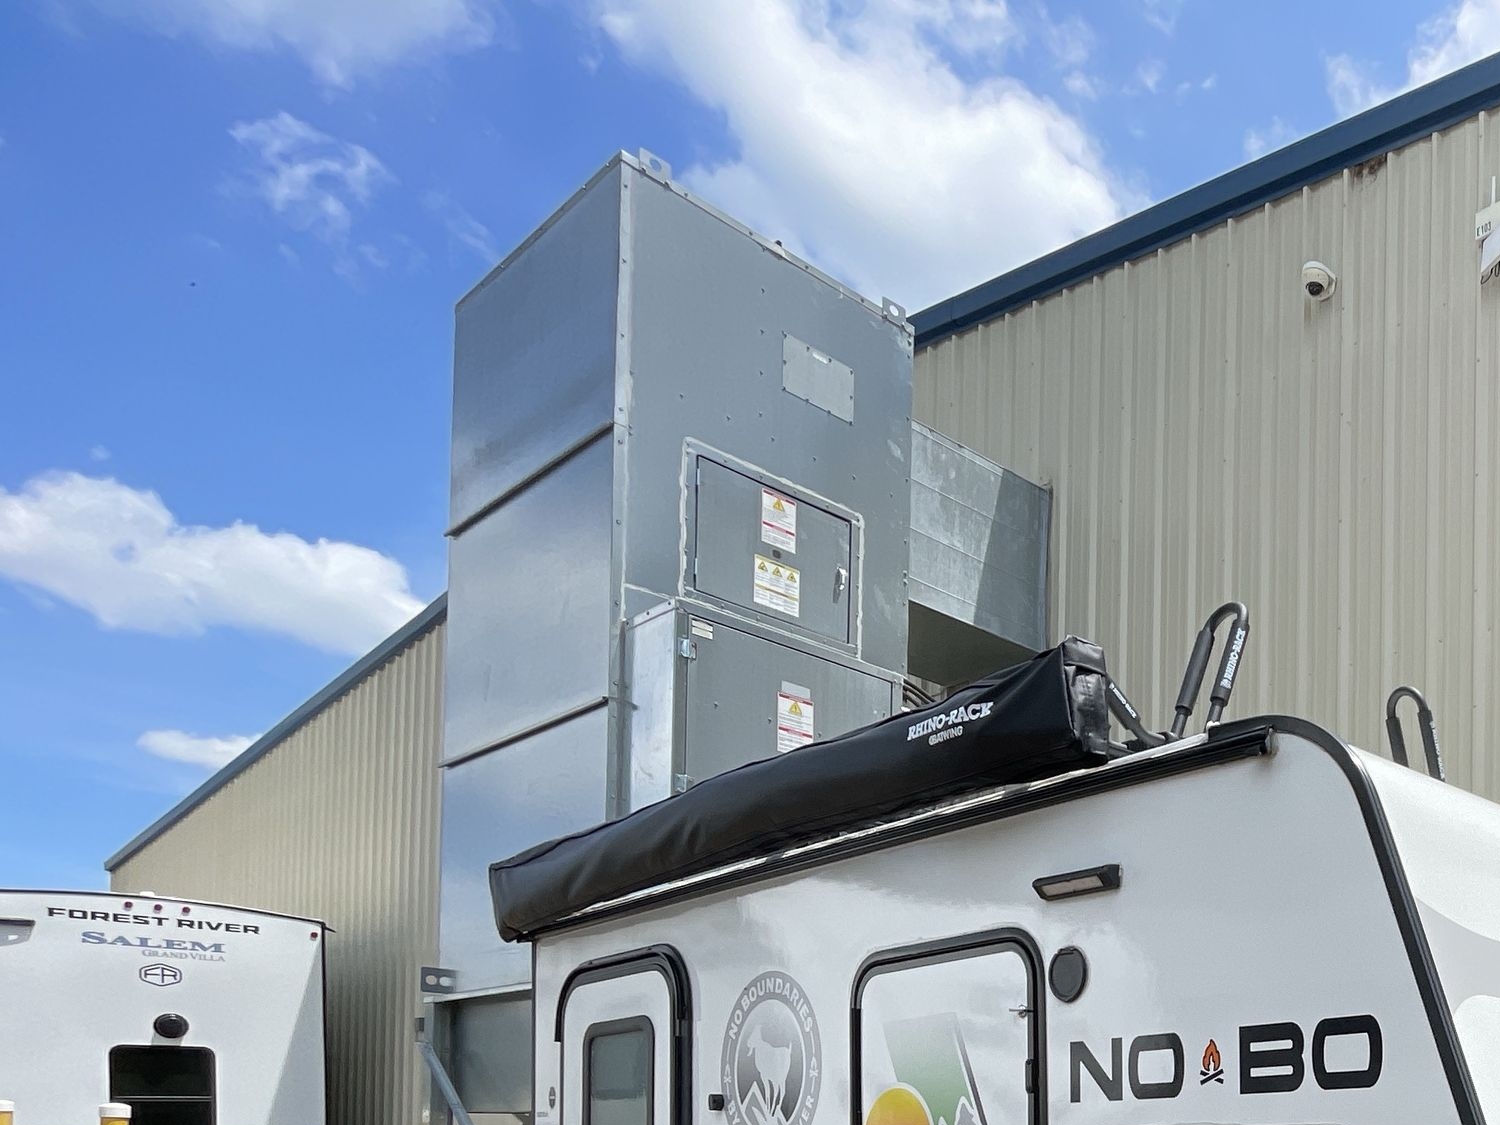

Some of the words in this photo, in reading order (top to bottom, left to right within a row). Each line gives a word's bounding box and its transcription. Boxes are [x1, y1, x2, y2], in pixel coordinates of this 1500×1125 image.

[907, 701, 994, 741] RHINO-RACK
[47, 907, 170, 927] FOREST
[176, 918, 261, 935] RIVER
[81, 931, 227, 953] SALEM
[142, 949, 189, 961] GRAND
[190, 952, 227, 963] VILLA
[728, 1008, 743, 1040] NO
[740, 977, 813, 1033] BOUNDARIES
[1069, 1032, 1185, 1104] NO
[1239, 1014, 1383, 1095] BO
[727, 1100, 741, 1125] BY
